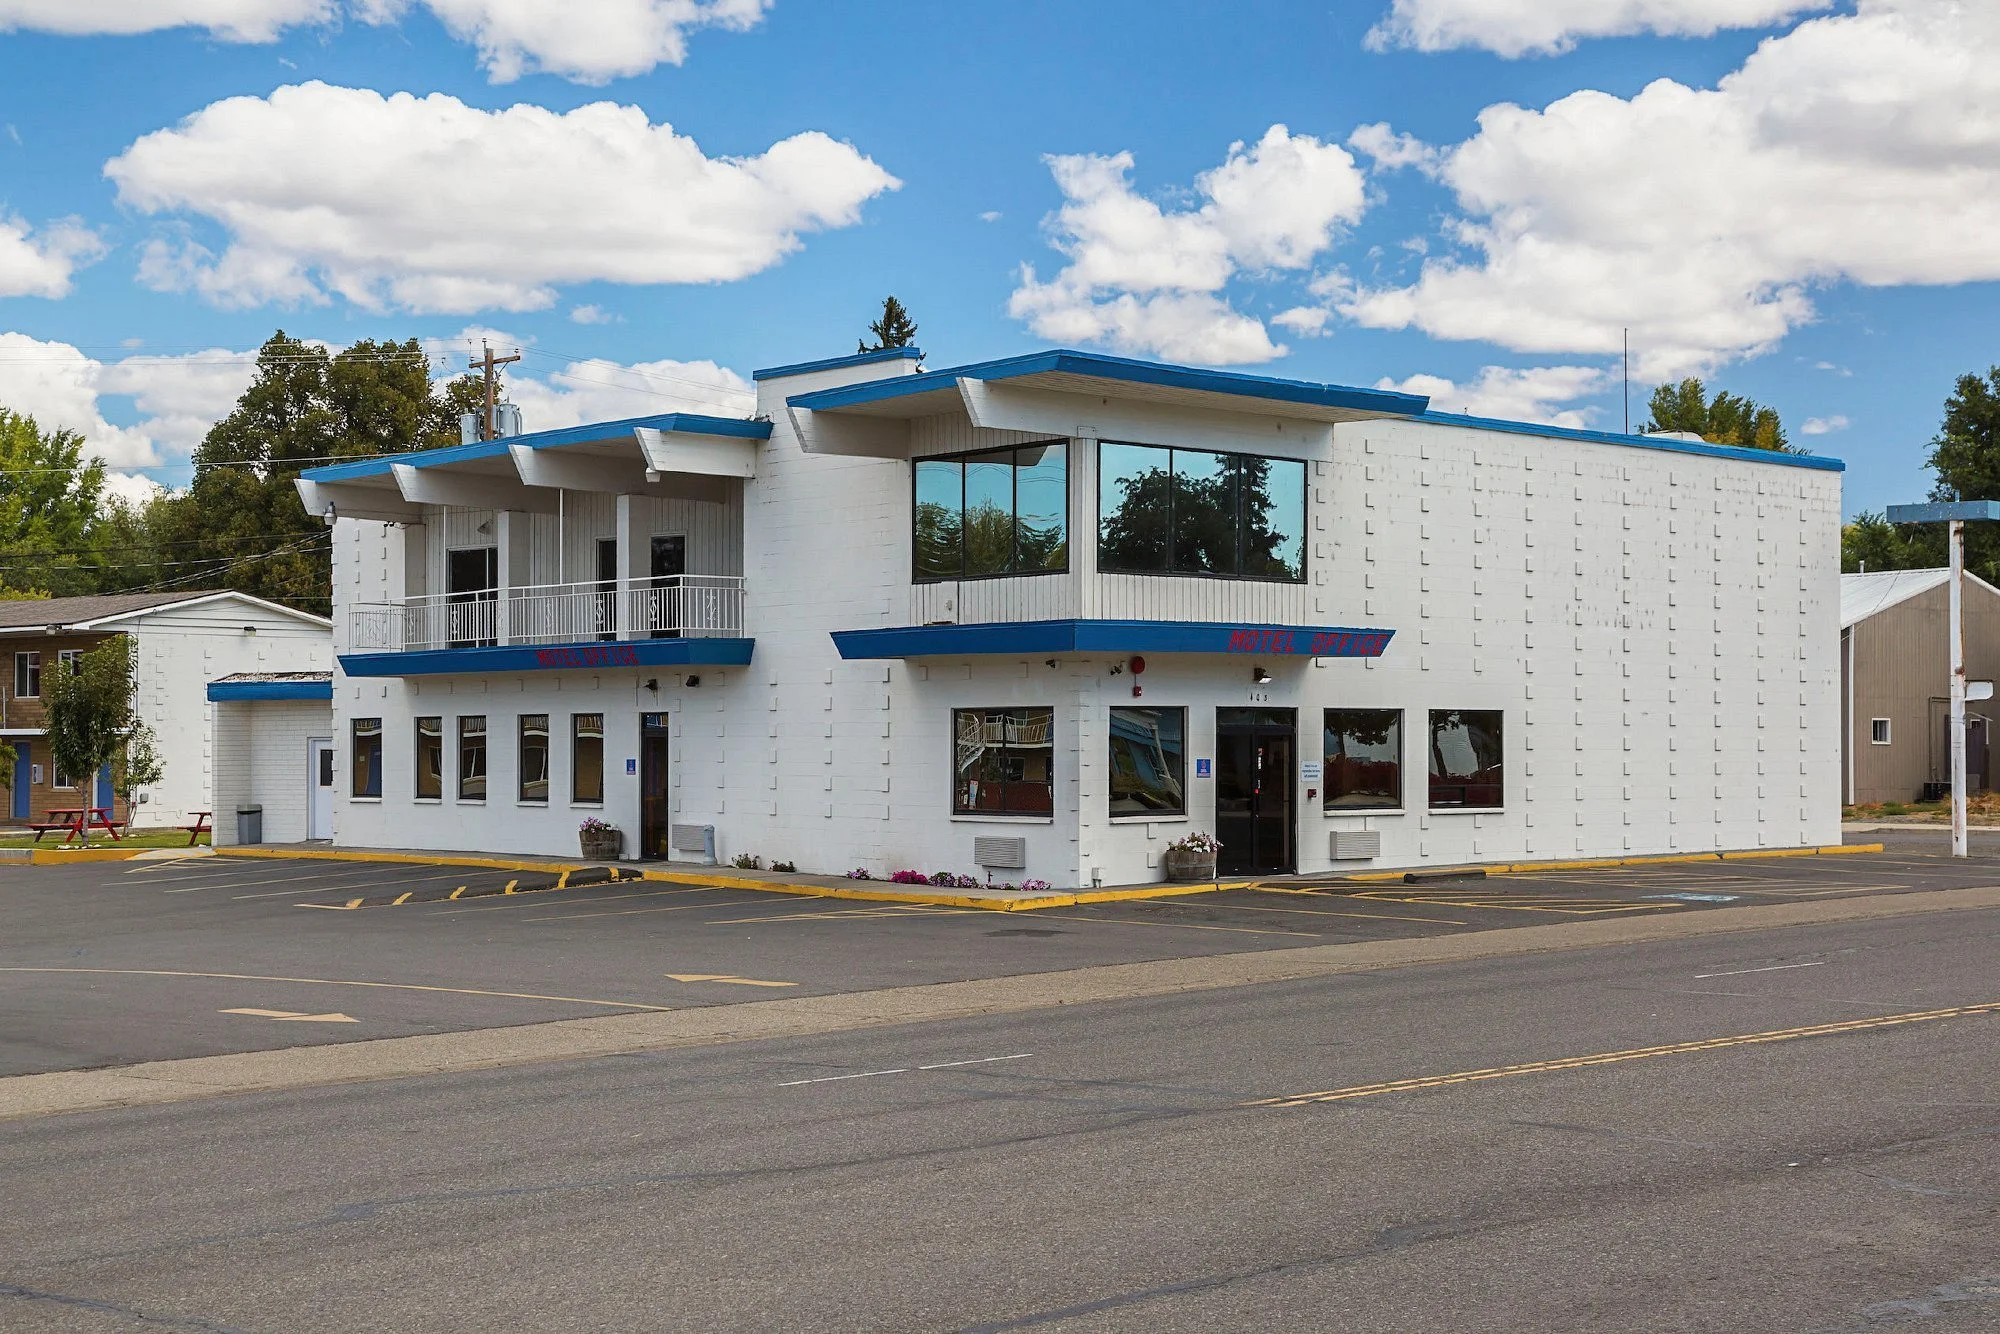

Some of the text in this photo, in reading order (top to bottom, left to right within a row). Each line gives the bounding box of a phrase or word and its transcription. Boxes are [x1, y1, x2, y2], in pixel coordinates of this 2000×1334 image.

[1228, 630, 1387, 655] MOTEL OFFICE
[537, 646, 639, 667] MOTEL OFFICE
